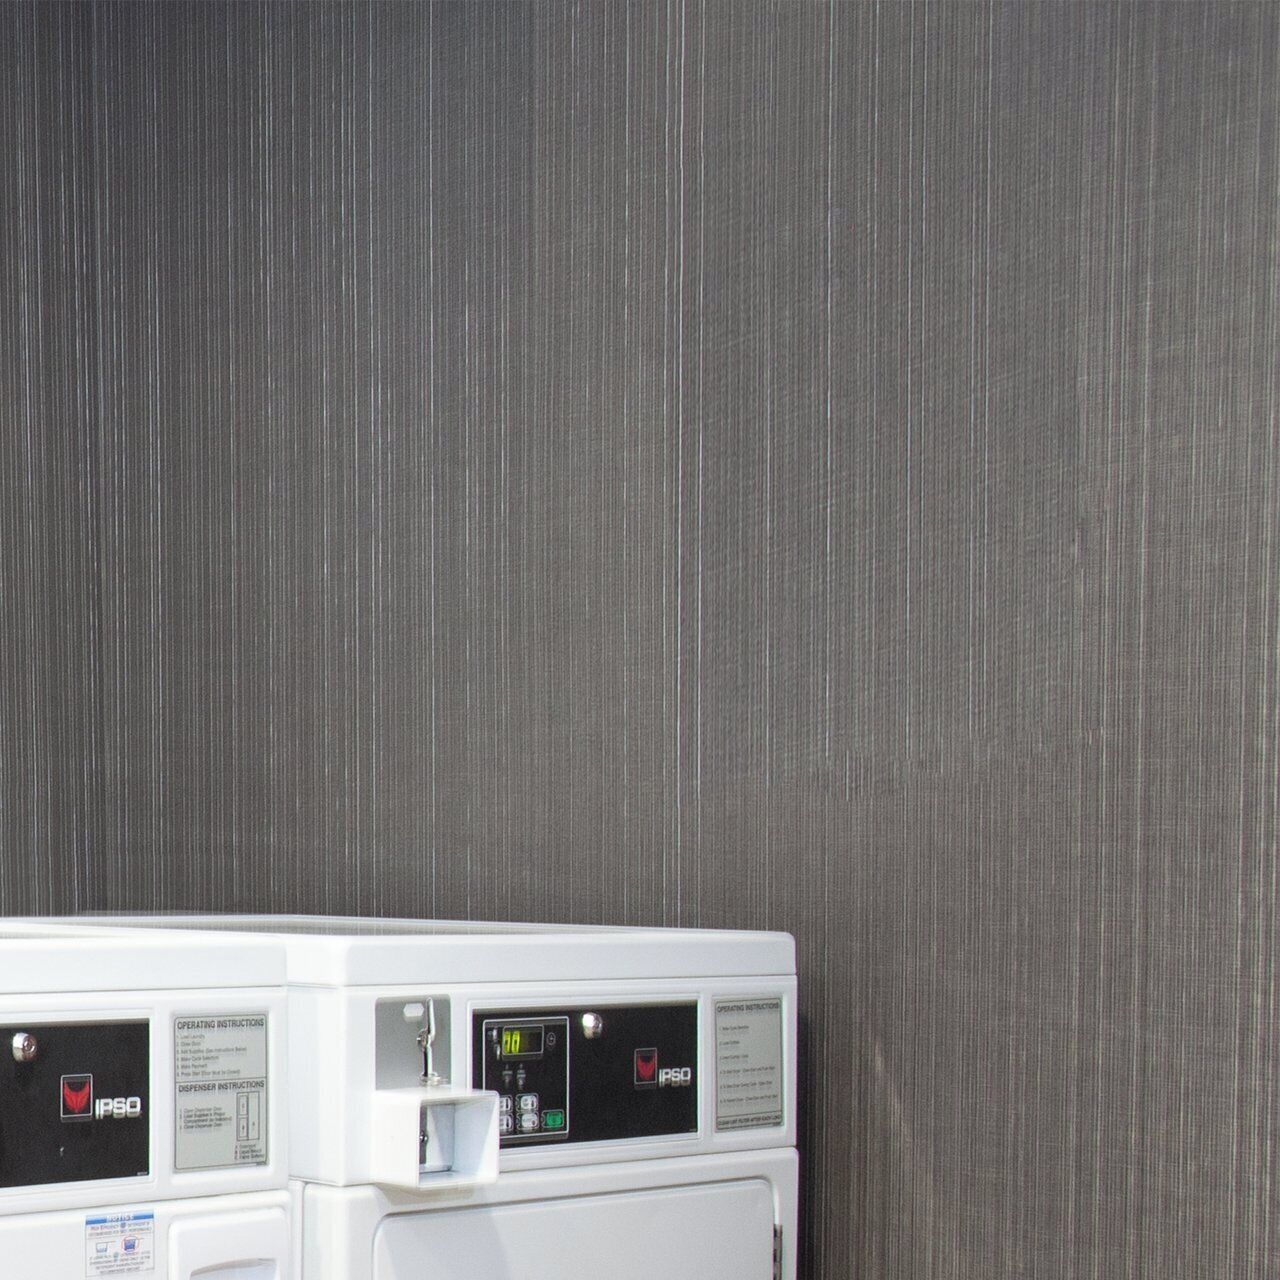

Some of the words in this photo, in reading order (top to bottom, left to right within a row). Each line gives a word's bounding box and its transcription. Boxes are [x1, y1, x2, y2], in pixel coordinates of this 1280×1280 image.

[177, 1020, 216, 1030] OPERATING
[217, 1018, 264, 1028] INSTRUCTIONS
[659, 1067, 691, 1082] IPSO
[179, 1083, 216, 1092] DISPENSER
[218, 1080, 264, 1090] INSTRUCTIONS
[95, 1096, 141, 1116] IPSO
